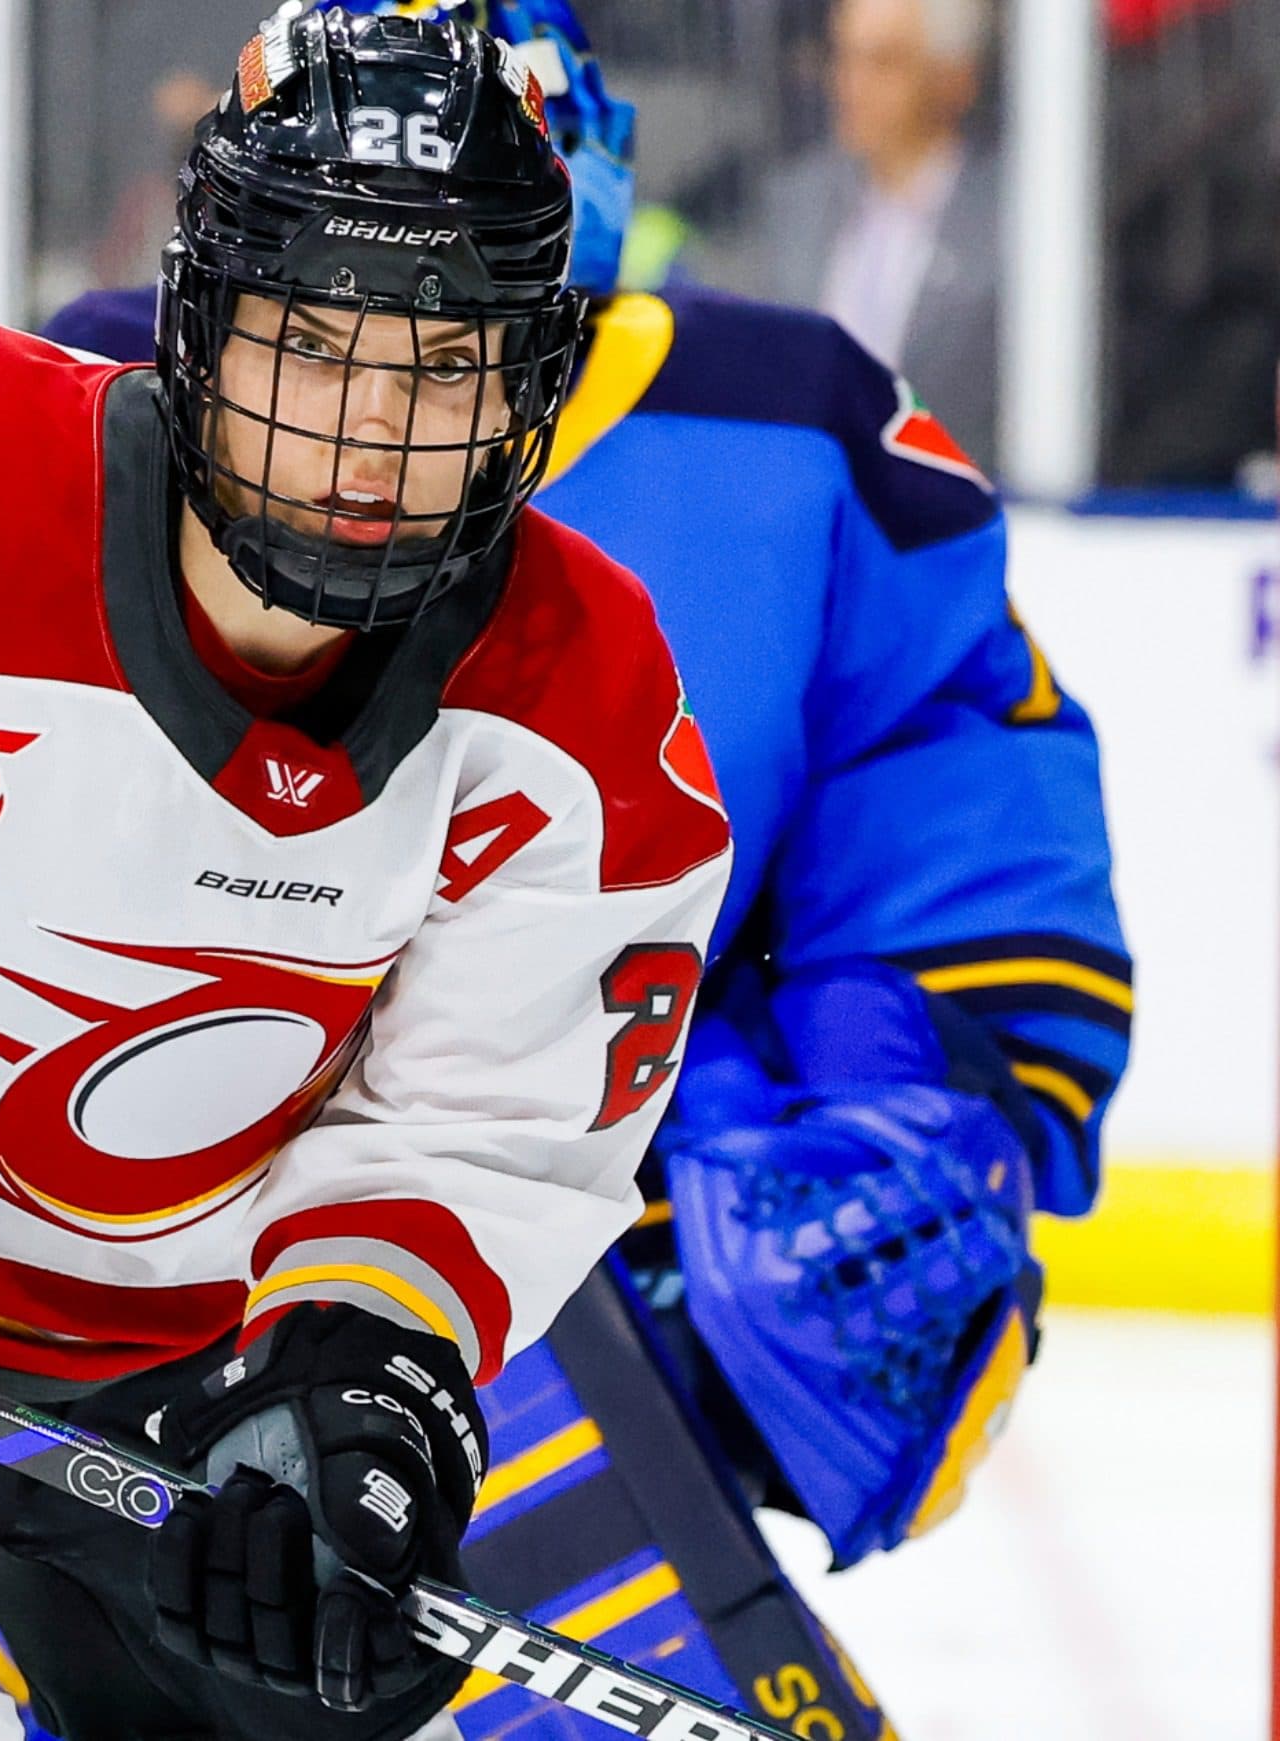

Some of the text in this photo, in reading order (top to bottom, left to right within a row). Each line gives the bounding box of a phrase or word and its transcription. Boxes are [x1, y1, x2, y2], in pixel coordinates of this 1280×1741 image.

[347, 105, 453, 172] 26
[324, 214, 459, 247] BAUER
[194, 870, 344, 907] BAUER
